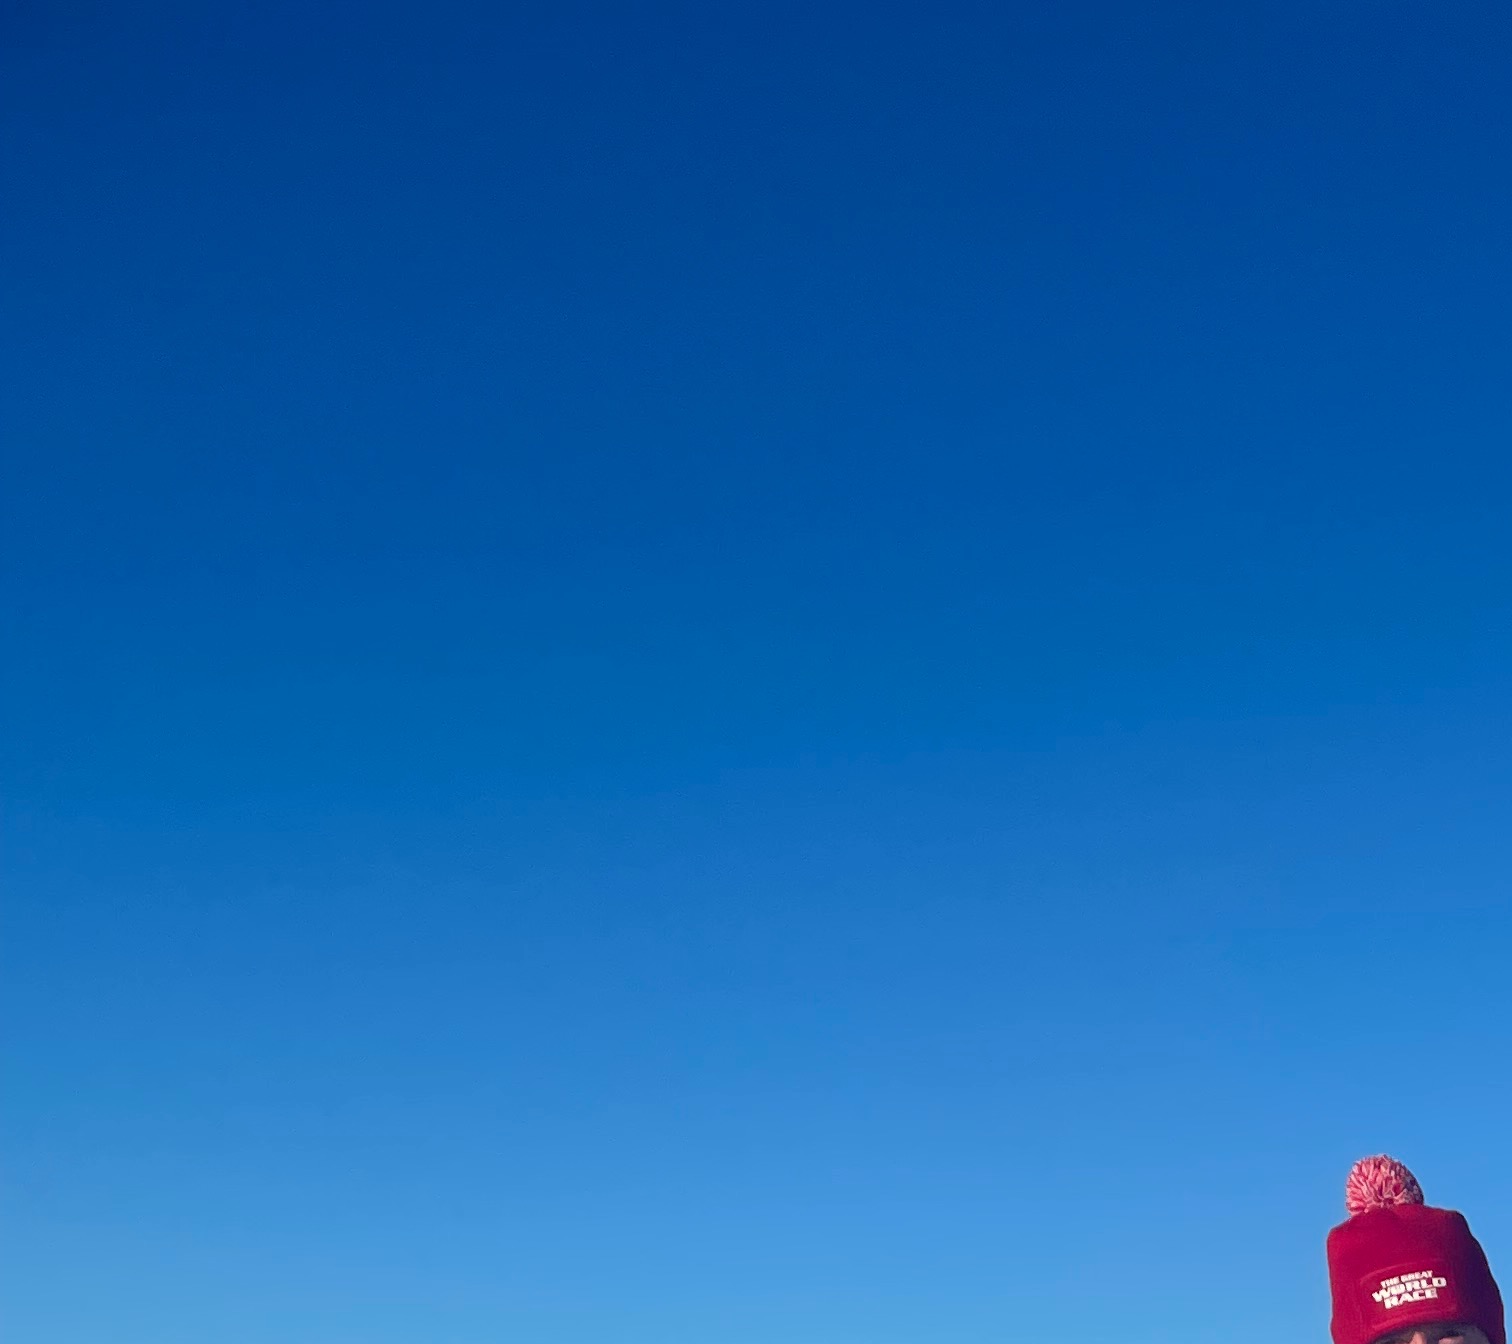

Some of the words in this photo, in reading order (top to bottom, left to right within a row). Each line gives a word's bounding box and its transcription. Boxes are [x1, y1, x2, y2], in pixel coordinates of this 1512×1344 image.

[1372, 1277, 1447, 1302] WORLD
[1380, 1276, 1400, 1289] THE
[1400, 1270, 1433, 1283] GREAT
[1383, 1288, 1438, 1309] RACE
